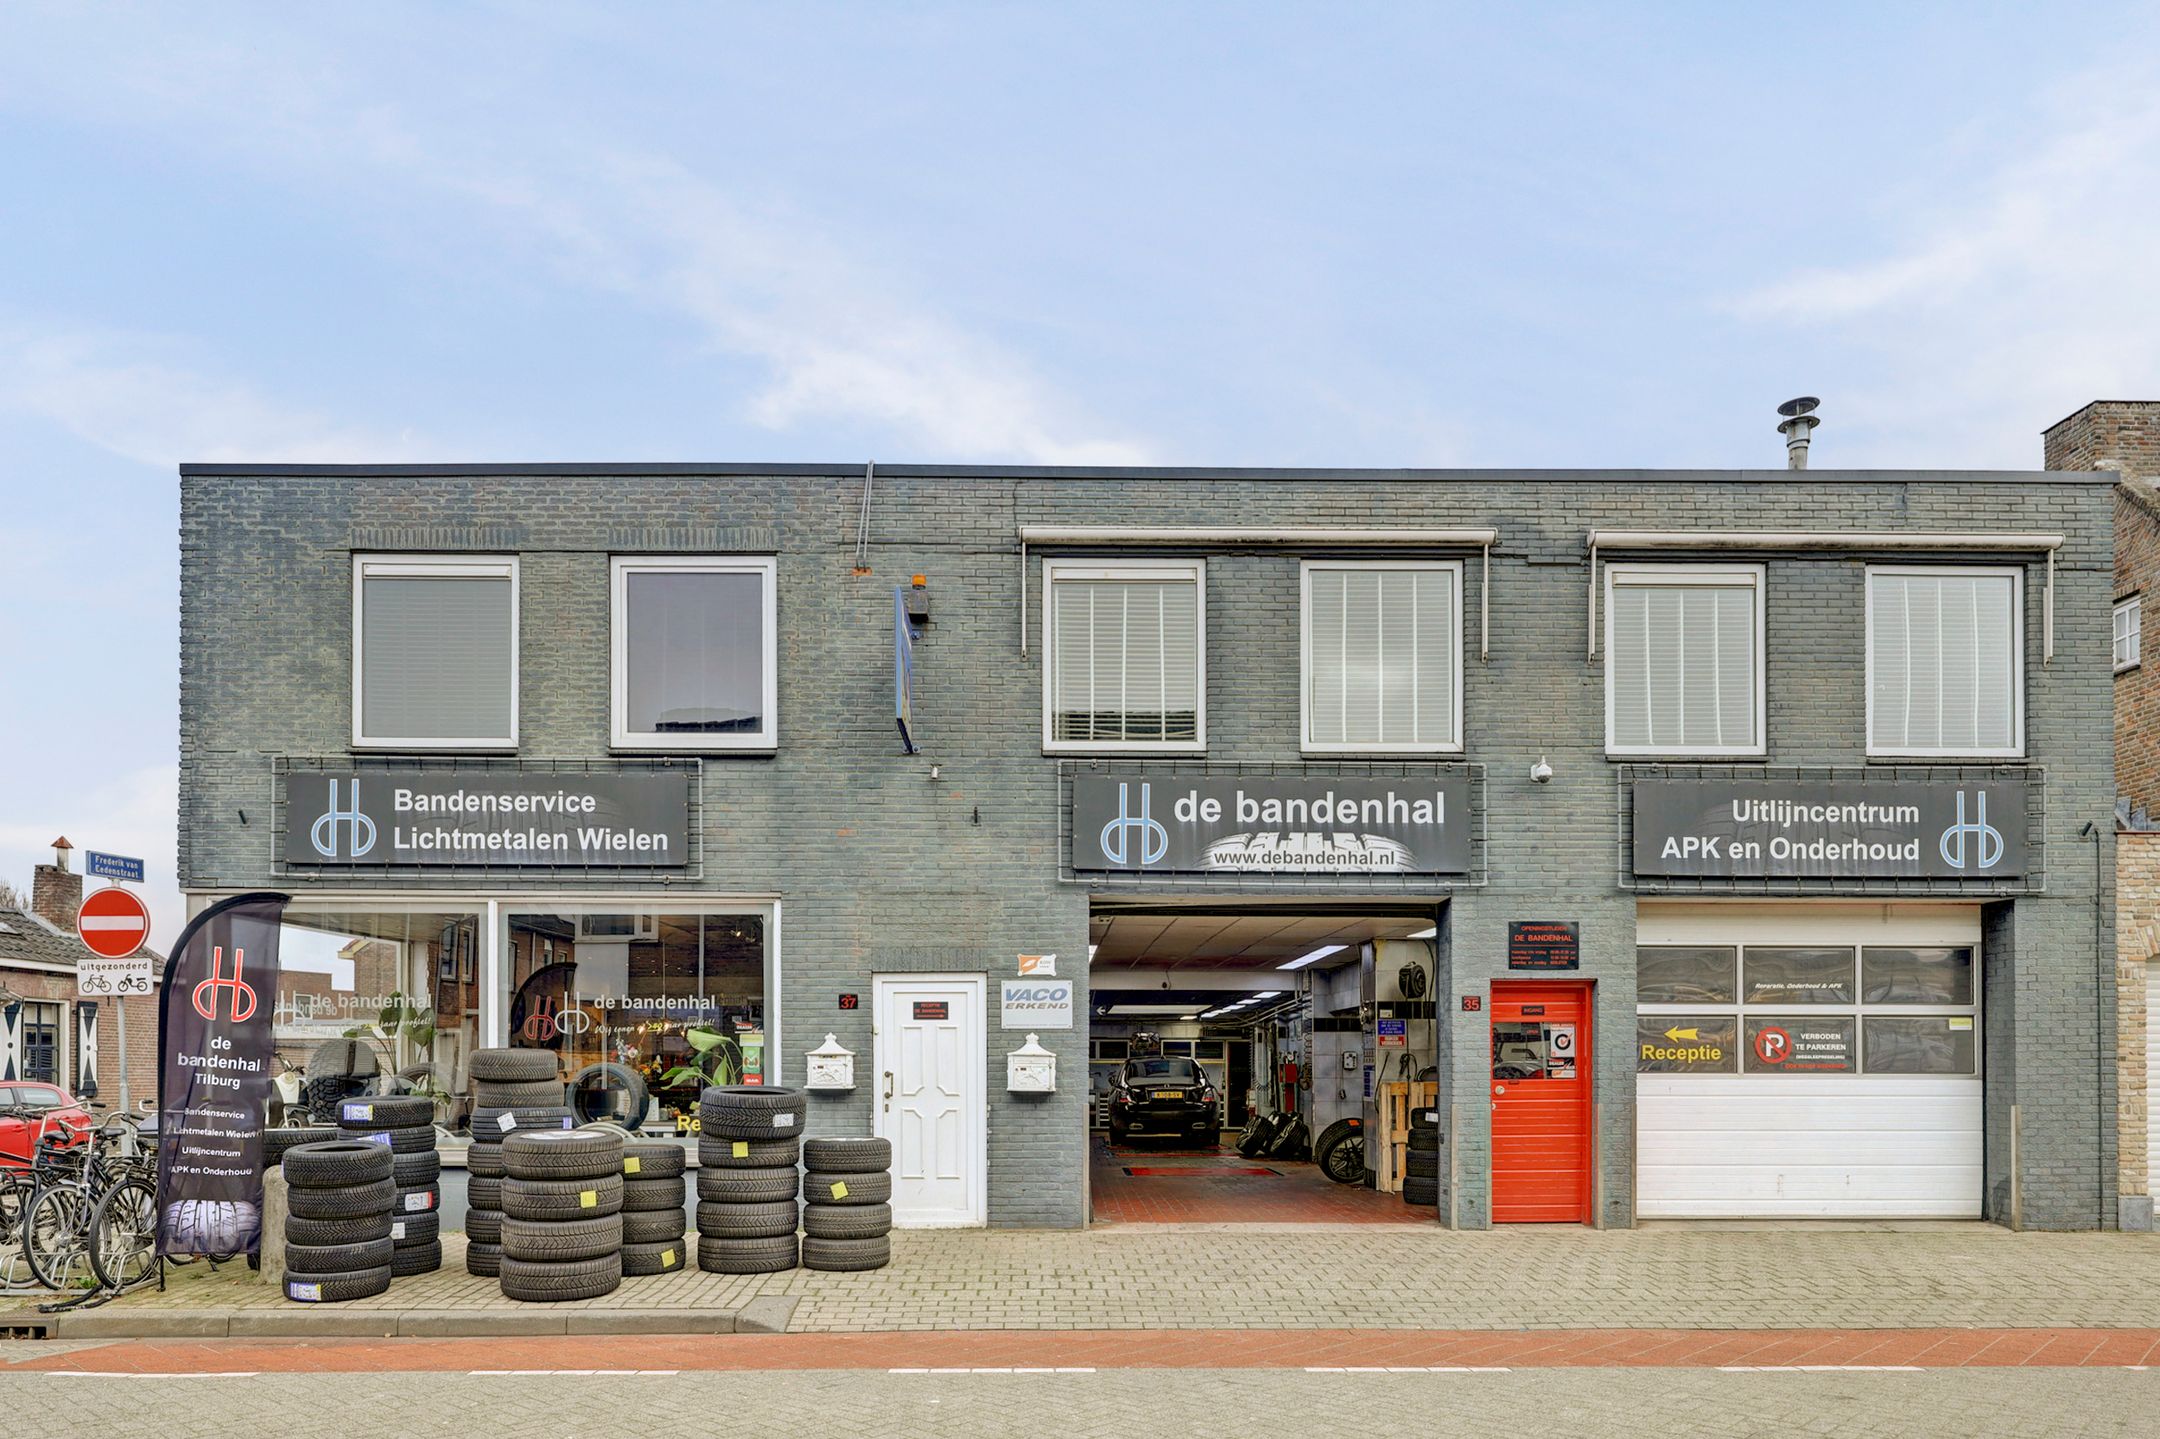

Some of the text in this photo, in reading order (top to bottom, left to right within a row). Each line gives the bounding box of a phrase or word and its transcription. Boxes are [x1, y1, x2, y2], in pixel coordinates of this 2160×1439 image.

[394, 789, 596, 813] Bandenservice
[1174, 790, 1444, 824] de bandenhal
[1733, 799, 1919, 828] Uitlijncentrum
[394, 827, 668, 850] Lichtmetalen Wielen
[1660, 837, 1919, 860] APK en Onderhoud
[95, 855, 138, 869] Frederik van
[1214, 851, 1395, 866] www.debandenhal.nl
[95, 865, 138, 879] Eedenstraat
[1514, 934, 1573, 942] DE BANDENHAL
[80, 962, 148, 972] uitgezonderd
[312, 993, 431, 1008] de bandenhal
[594, 994, 615, 1009] de
[622, 994, 715, 1009] bandenhal
[1005, 988, 1068, 1001] VACO
[840, 998, 856, 1009] 37
[1005, 1002, 1069, 1010] ERKEND
[1463, 999, 1480, 1010] 35
[210, 1036, 232, 1050] de
[1641, 1045, 1721, 1063] Receptie
[177, 1052, 261, 1072] bandenhal
[195, 1073, 241, 1090] Tilburg
[184, 1107, 245, 1119] Bandenservice
[171, 1166, 189, 1174] APK
